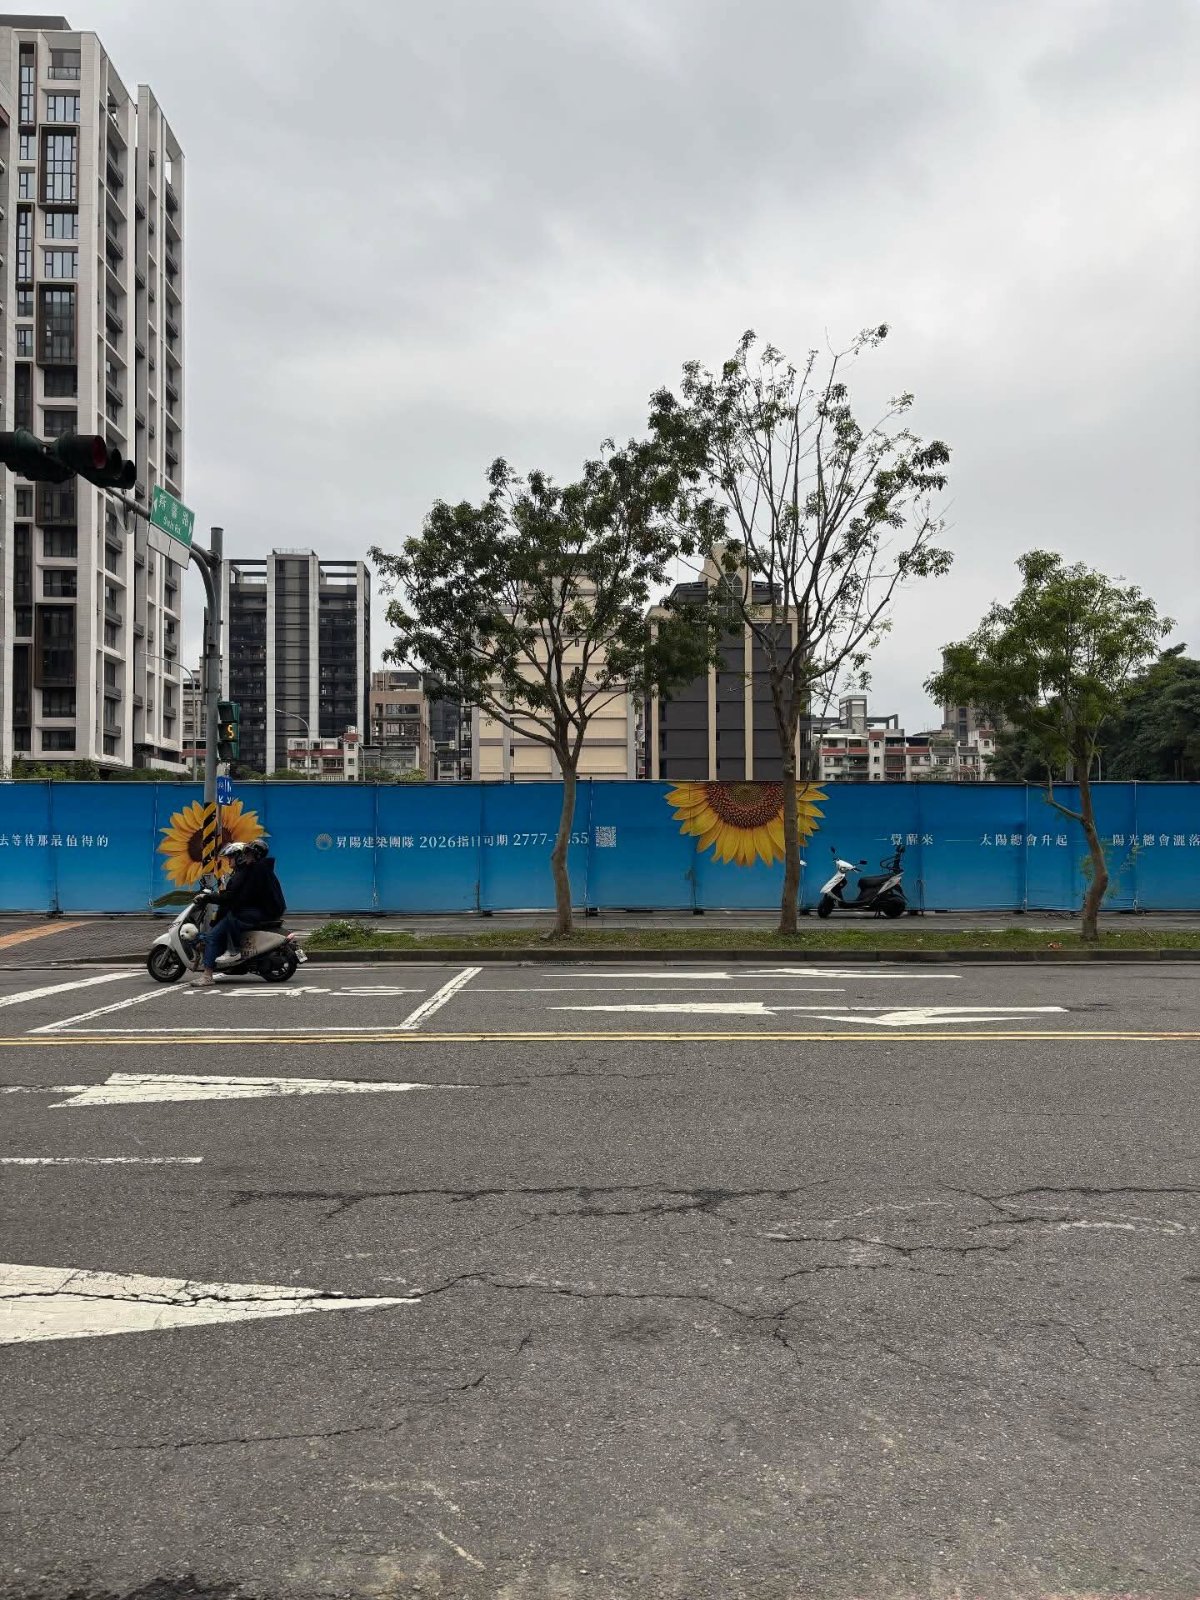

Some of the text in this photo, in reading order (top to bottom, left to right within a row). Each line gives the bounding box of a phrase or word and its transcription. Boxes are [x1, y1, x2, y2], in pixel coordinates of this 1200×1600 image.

[0, 834, 108, 848] 去等待那最值得的
[980, 833, 1068, 846] 太陽總會升起
